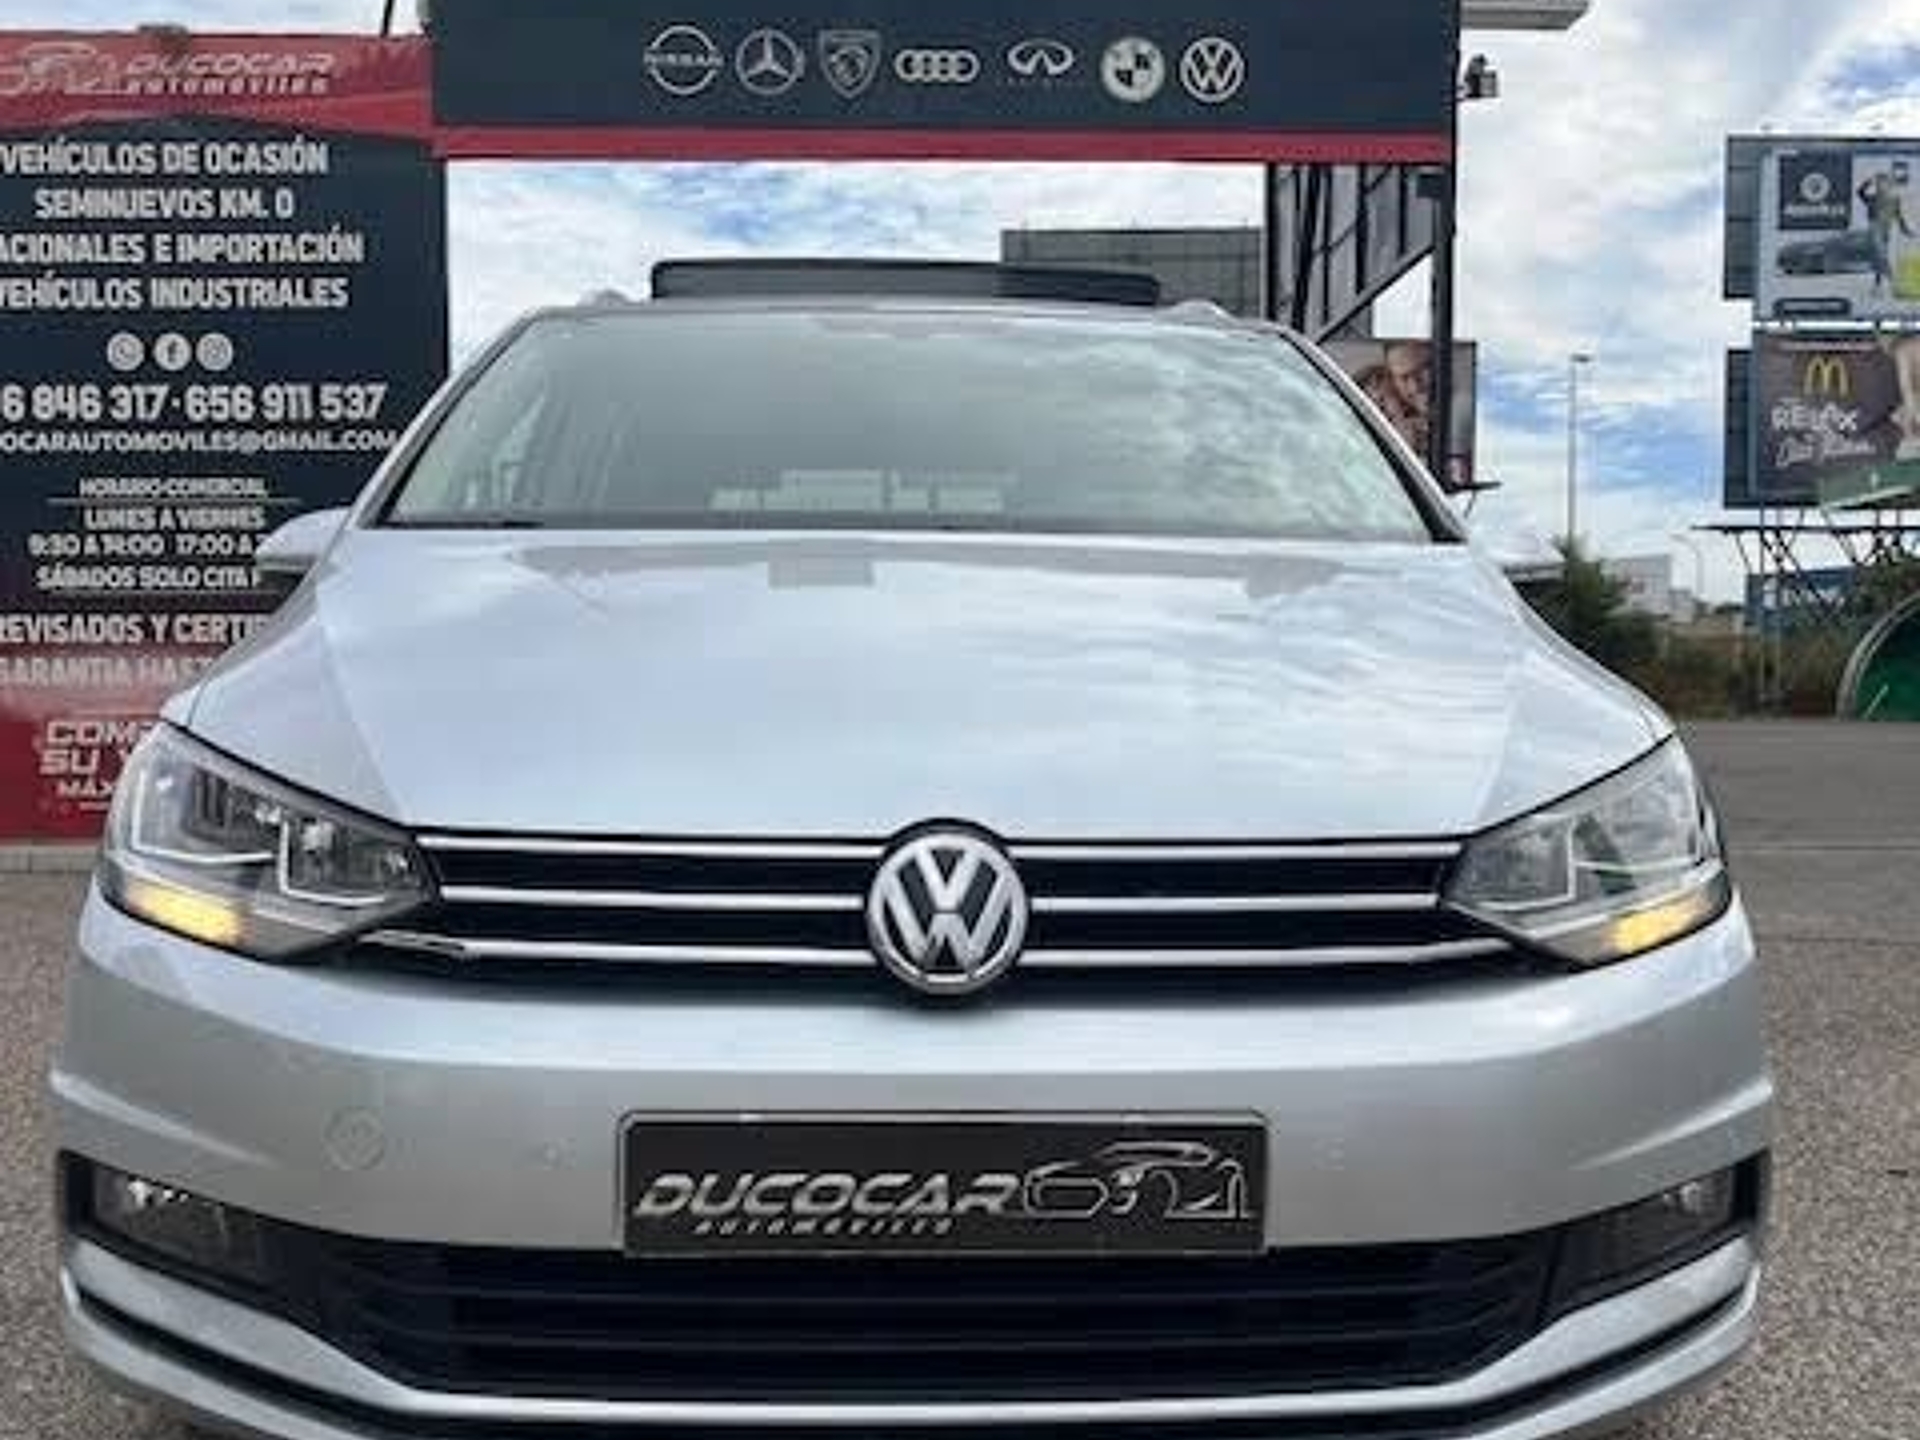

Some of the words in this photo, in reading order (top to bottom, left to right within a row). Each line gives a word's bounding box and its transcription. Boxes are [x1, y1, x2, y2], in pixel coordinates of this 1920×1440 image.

[0, 135, 156, 174] VEHÍCULOS
[164, 144, 197, 173] DE
[204, 135, 329, 174] OCASIÓN
[35, 189, 215, 219] SEMINUEVOS
[220, 188, 268, 218] KM.
[155, 234, 171, 263] E
[177, 224, 363, 264] IMPORTACIÓN
[151, 278, 348, 308] INDUSTRIALES
[32, 385, 101, 420] 846
[109, 384, 170, 421] 317
[186, 384, 255, 421] 656
[263, 384, 313, 420] 911
[320, 383, 388, 421] 537
[84, 508, 156, 530] LUNES
[160, 508, 175, 530] A
[177, 507, 265, 530] VIERNES
[83, 534, 100, 555] A
[239, 534, 253, 555] A
[139, 566, 200, 587] SOLO
[203, 566, 249, 587] CITA
[151, 614, 169, 643] Y
[633, 1172, 1019, 1217] DUCOCAR
